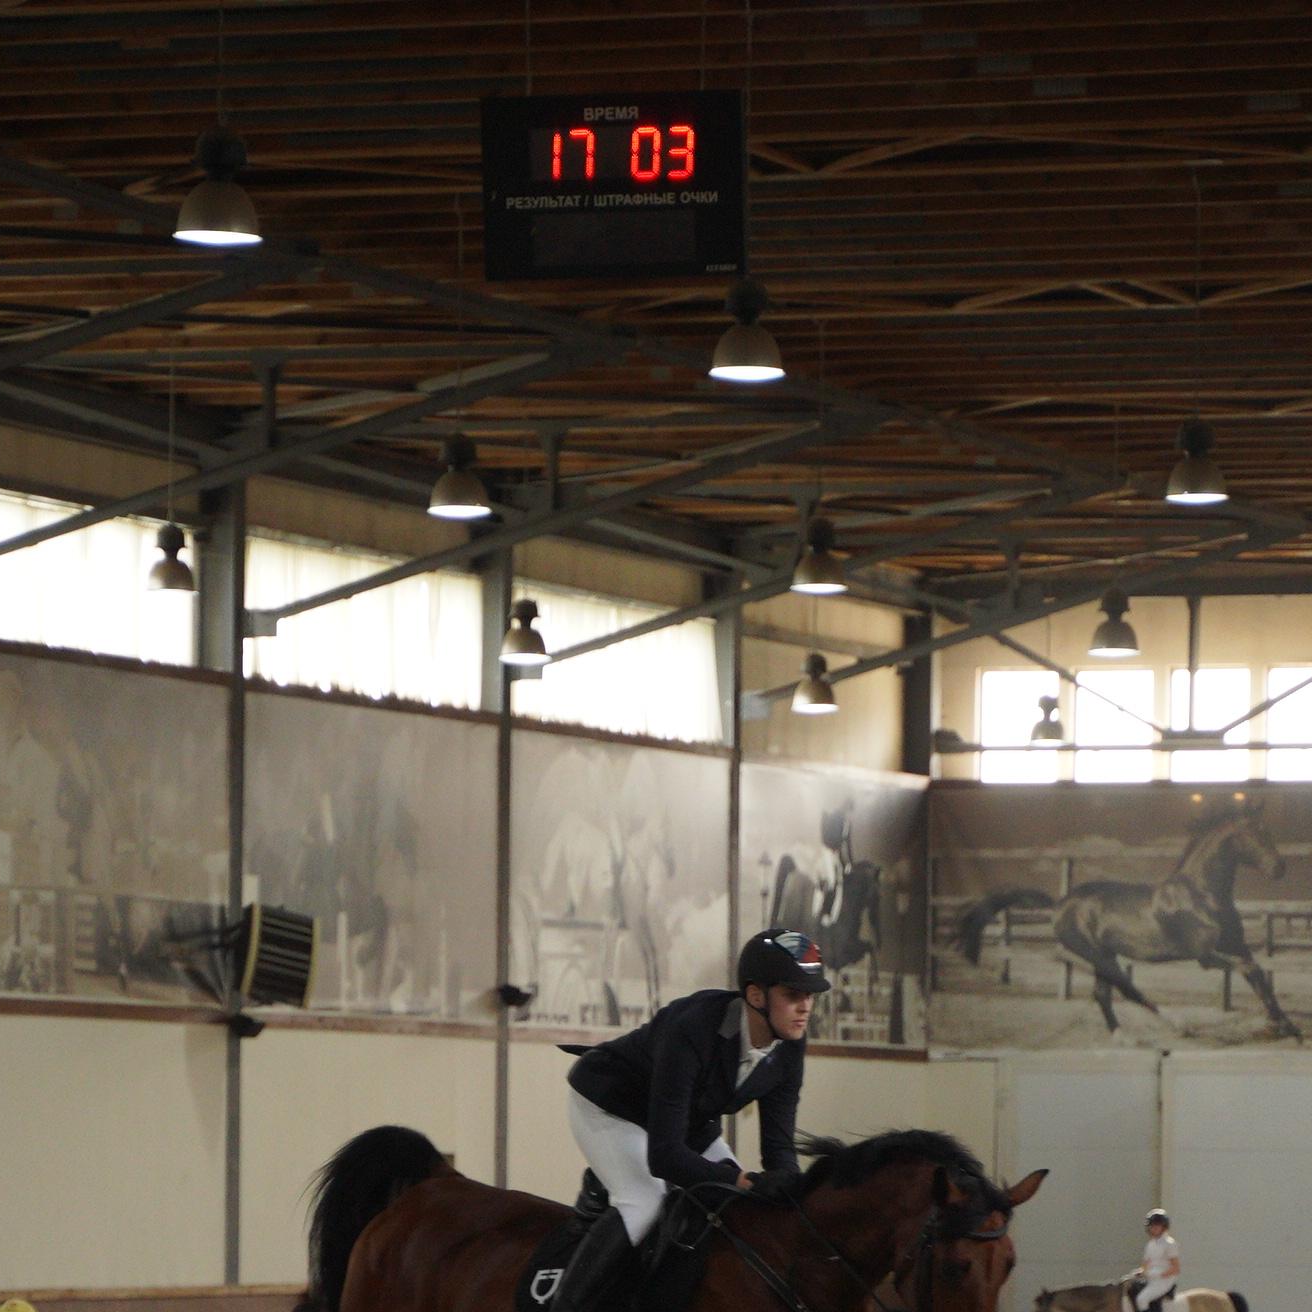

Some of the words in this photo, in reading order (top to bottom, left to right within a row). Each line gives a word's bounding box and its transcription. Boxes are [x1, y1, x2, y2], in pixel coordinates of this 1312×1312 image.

[584, 106, 639, 121] ВРЕМЯ
[552, 128, 596, 181] 17
[630, 125, 696, 182] 03
[506, 194, 581, 210] РЕЗУЛЬТАТ
[594, 192, 676, 207] ШТРАФНЫЕ
[680, 190, 719, 205] ОЧКИ
